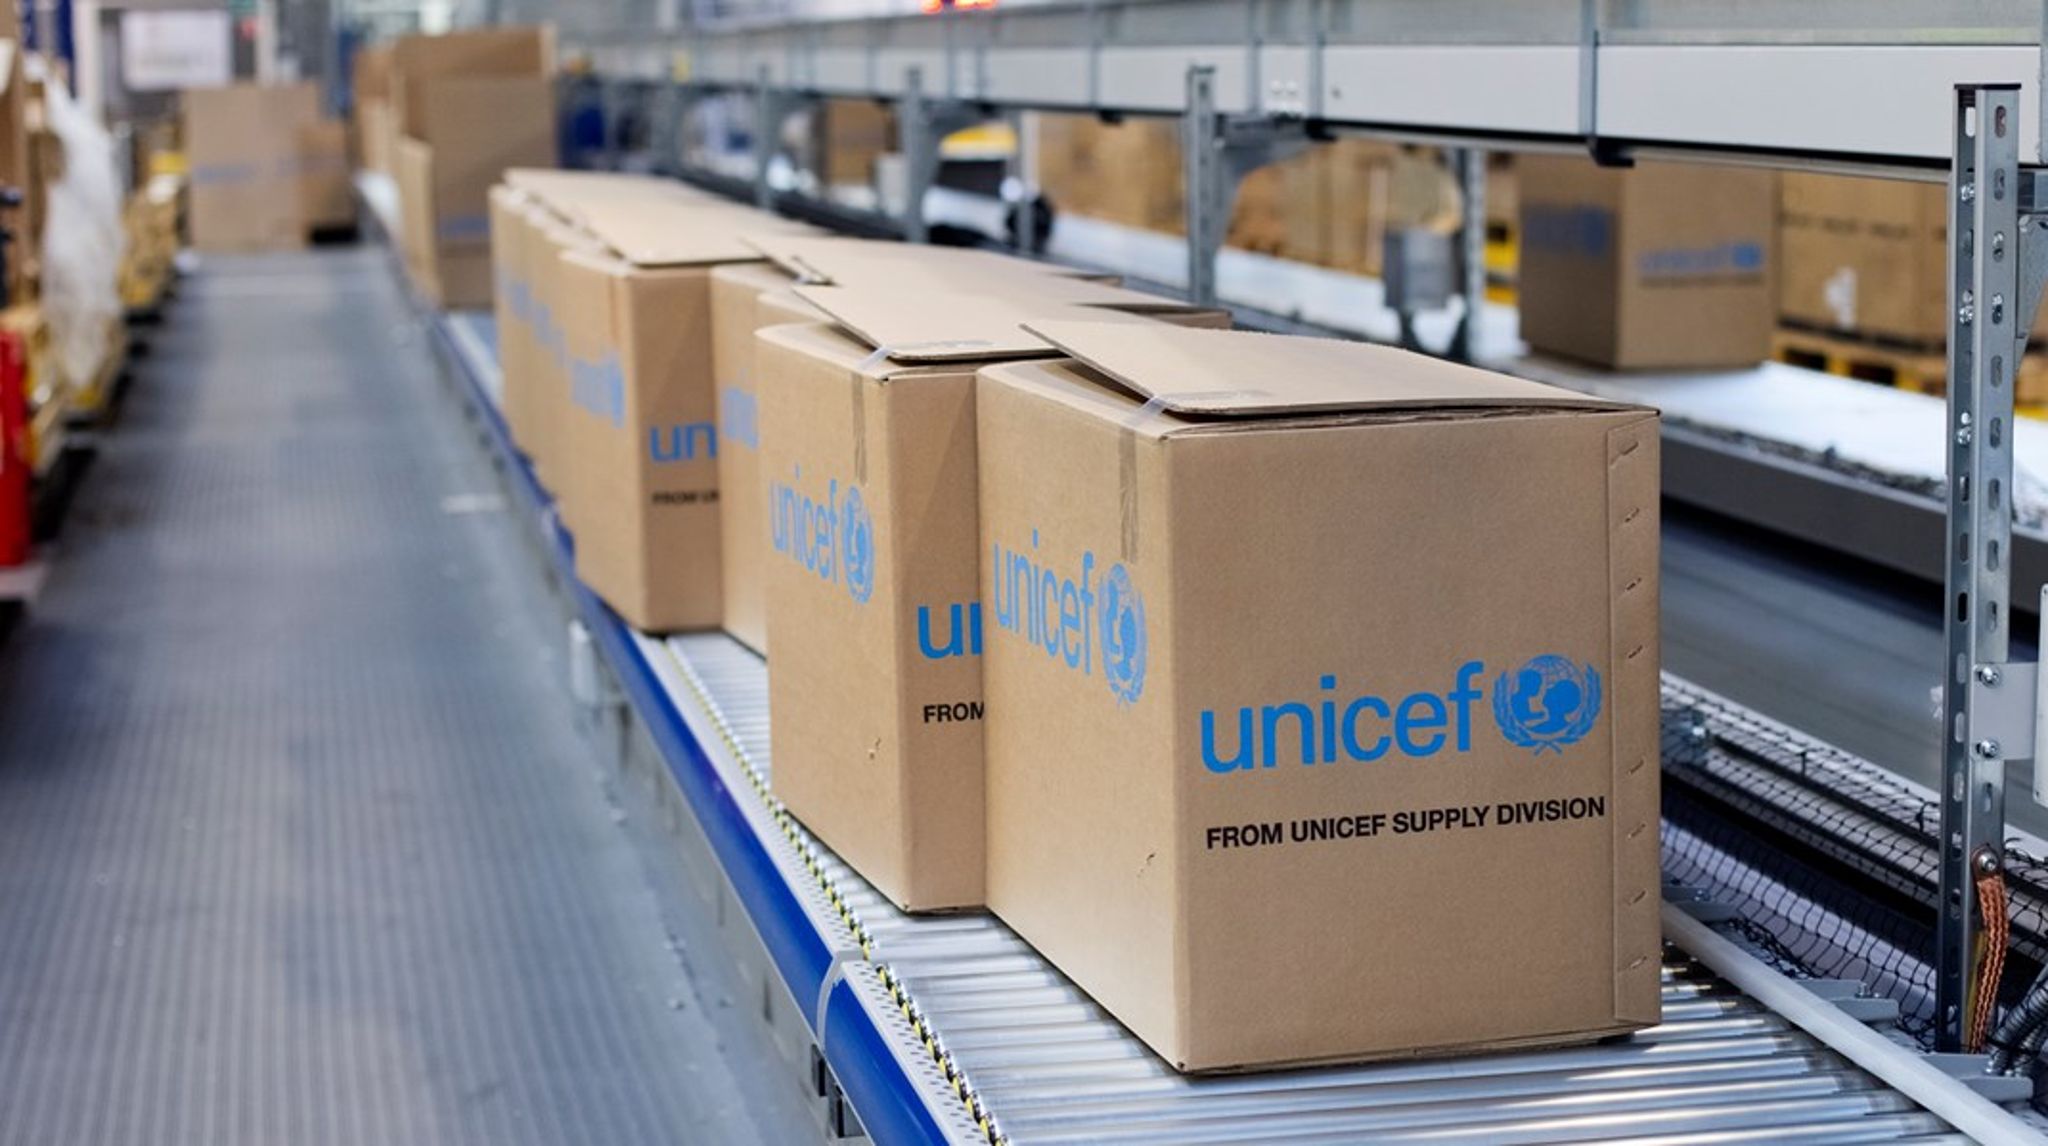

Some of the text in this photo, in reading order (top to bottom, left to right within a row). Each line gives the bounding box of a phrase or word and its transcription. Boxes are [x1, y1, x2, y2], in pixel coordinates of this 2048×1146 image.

[768, 462, 838, 584] unicef
[994, 528, 1094, 676] unicef
[923, 702, 985, 724] FROM
[1201, 661, 1485, 774] unicef
[1206, 796, 1606, 849] FROM UNICEF SUPPLY DIVISION
